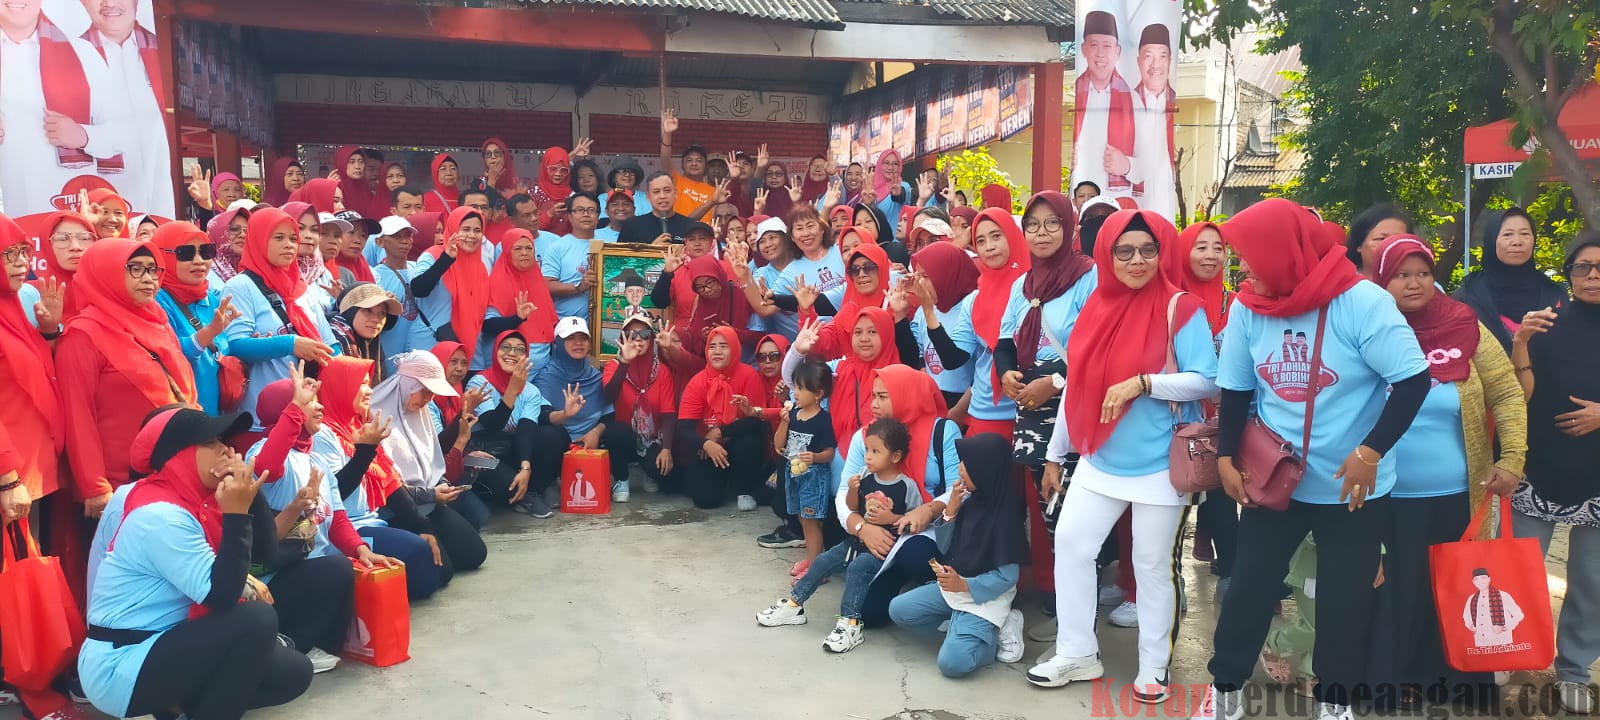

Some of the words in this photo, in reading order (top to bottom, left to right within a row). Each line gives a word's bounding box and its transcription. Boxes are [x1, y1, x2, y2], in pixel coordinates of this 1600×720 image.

[767, 95, 807, 121] 78
[1001, 109, 1030, 138] KEREN
[940, 129, 963, 149] KEREN
[969, 121, 995, 146] KEREN
[1480, 165, 1515, 175] KASIR
[64, 194, 77, 204] TRI
[1267, 362, 1280, 375] TRI
[1272, 373, 1280, 384] &
